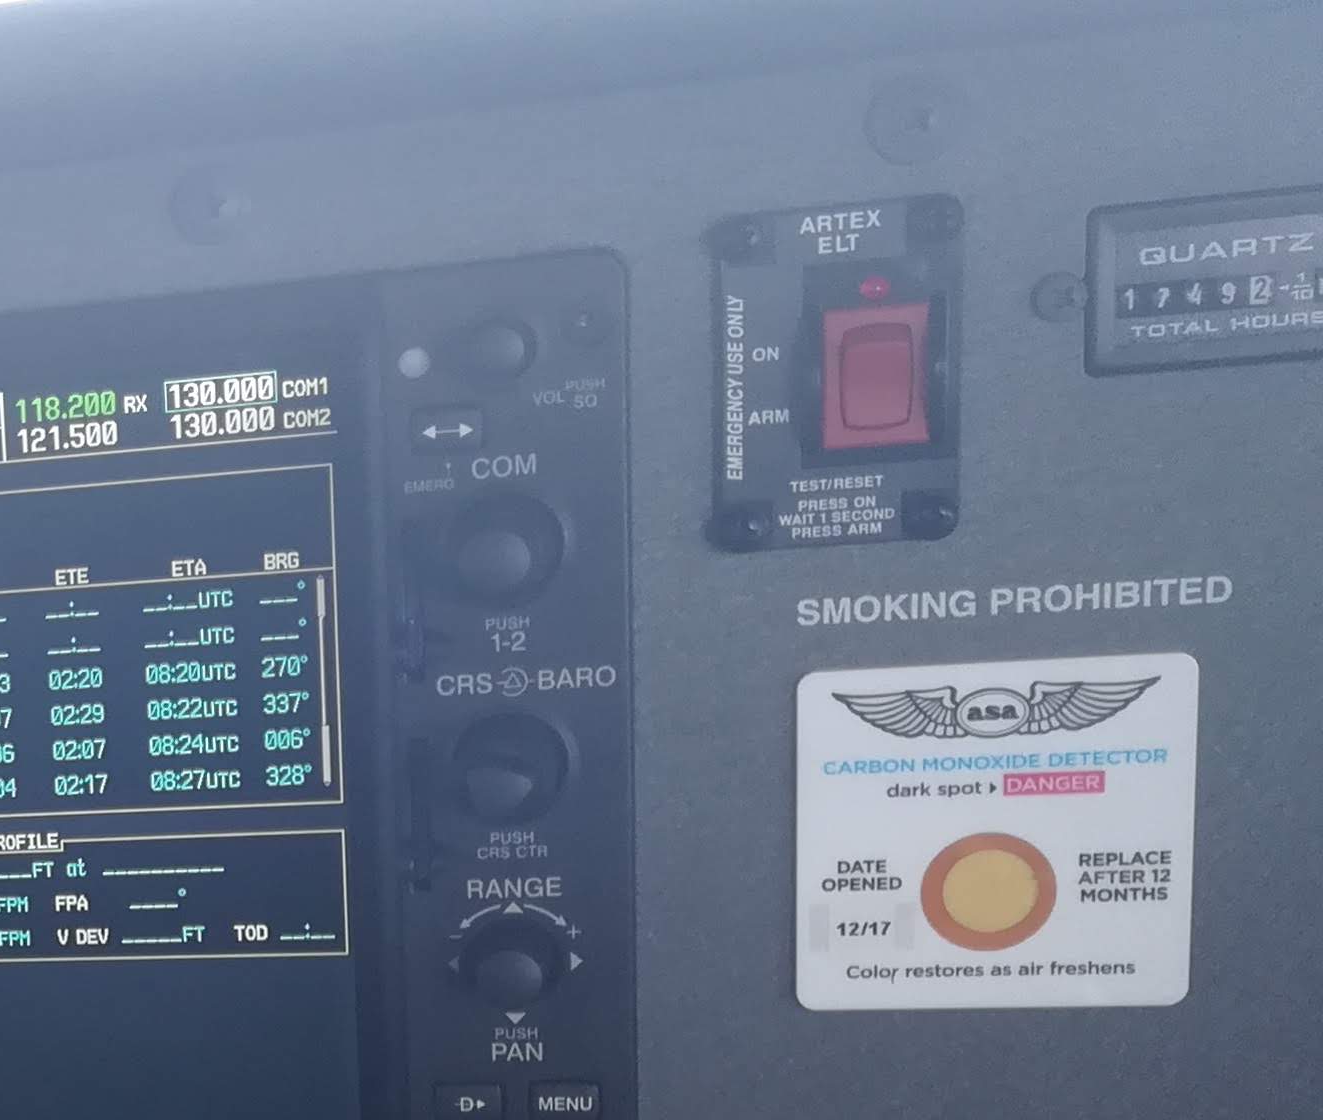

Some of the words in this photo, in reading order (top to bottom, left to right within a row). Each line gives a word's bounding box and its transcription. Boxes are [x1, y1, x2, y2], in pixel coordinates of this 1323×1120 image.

[800, 210, 881, 235] ARTEX
[818, 234, 859, 254] ELT
[1139, 232, 1314, 265] QUARTZ
[726, 295, 744, 340] ONLY
[1130, 320, 1219, 337] TOTAL
[726, 343, 743, 376] USE
[753, 348, 779, 361] ON
[169, 375, 274, 409] 130.000
[282, 378, 328, 398] COM1
[15, 392, 115, 423] 118.200
[124, 394, 147, 414] RX
[748, 409, 789, 425] ARM
[170, 407, 275, 439] 130.000
[283, 408, 331, 429] COM2
[726, 378, 743, 480] EMERGENCY
[17, 421, 117, 453] 121.500
[471, 453, 537, 479] COM
[790, 475, 884, 493] TEST/RESET
[798, 497, 850, 512] PRESS
[854, 496, 876, 508] ON
[779, 513, 816, 526] WAIT
[821, 512, 827, 524] 1
[831, 508, 895, 523] SECOND
[792, 525, 843, 539] PRESS
[847, 523, 882, 535] ARM
[55, 567, 88, 585] ETE
[172, 558, 207, 577] ETA
[264, 551, 299, 571] BRG
[797, 589, 977, 626] SMOKING
[990, 575, 1232, 615] PROHIBITED
[49, 669, 103, 690] 02:20
[436, 674, 492, 696] CRS
[538, 666, 616, 690] BARO
[823, 759, 916, 775] CARBON
[922, 753, 1040, 771] MONOXIDE
[1048, 748, 1168, 767] DETECTOR
[887, 781, 931, 798] dark
[937, 780, 982, 799] spot
[1007, 775, 1100, 793] DANGER
[837, 860, 887, 874] DATE
[1078, 851, 1171, 867] REPLACE
[821, 877, 902, 892] OPENED
[1078, 870, 1146, 885] AFTER
[1151, 868, 1171, 883] 12
[467, 877, 562, 899] RANGE
[1080, 887, 1168, 903] MONTHS
[836, 921, 890, 937] 12/17
[846, 964, 899, 984] Color
[905, 963, 984, 978] restores
[990, 965, 1012, 977] as
[1018, 962, 1044, 976] air
[1050, 960, 1135, 975] freshens
[492, 1042, 543, 1062] PAN
[539, 1096, 593, 1111] MENU
